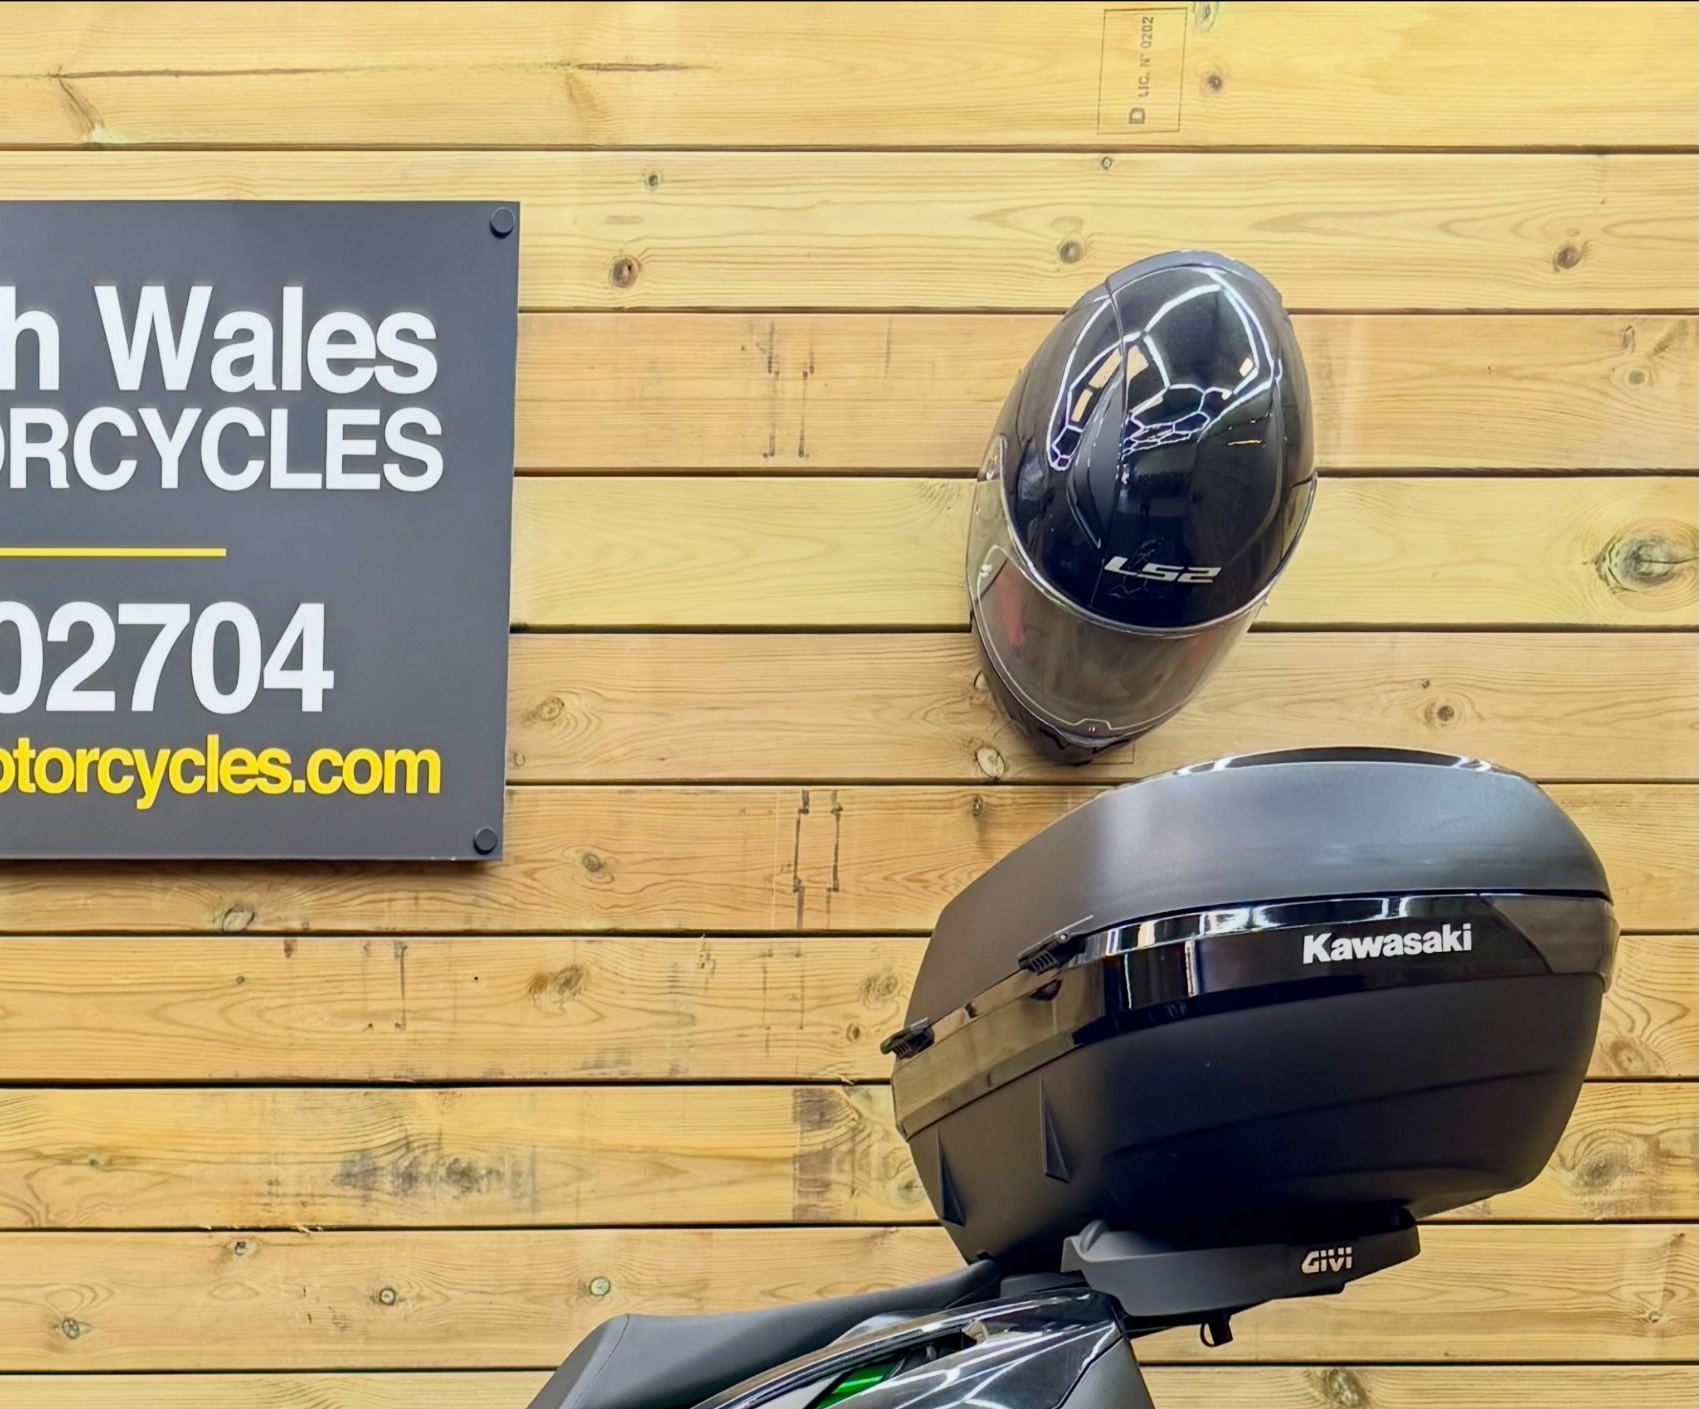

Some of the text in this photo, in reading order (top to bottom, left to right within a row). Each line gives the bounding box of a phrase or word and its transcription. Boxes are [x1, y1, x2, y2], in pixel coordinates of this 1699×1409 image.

[1140, 16, 1155, 48] 0202
[1137, 71, 1150, 97] LIC.
[1128, 107, 1146, 124] D
[93, 284, 438, 395] Wales
[1104, 555, 1222, 584] LS2
[1302, 923, 1473, 965] Kawasaki
